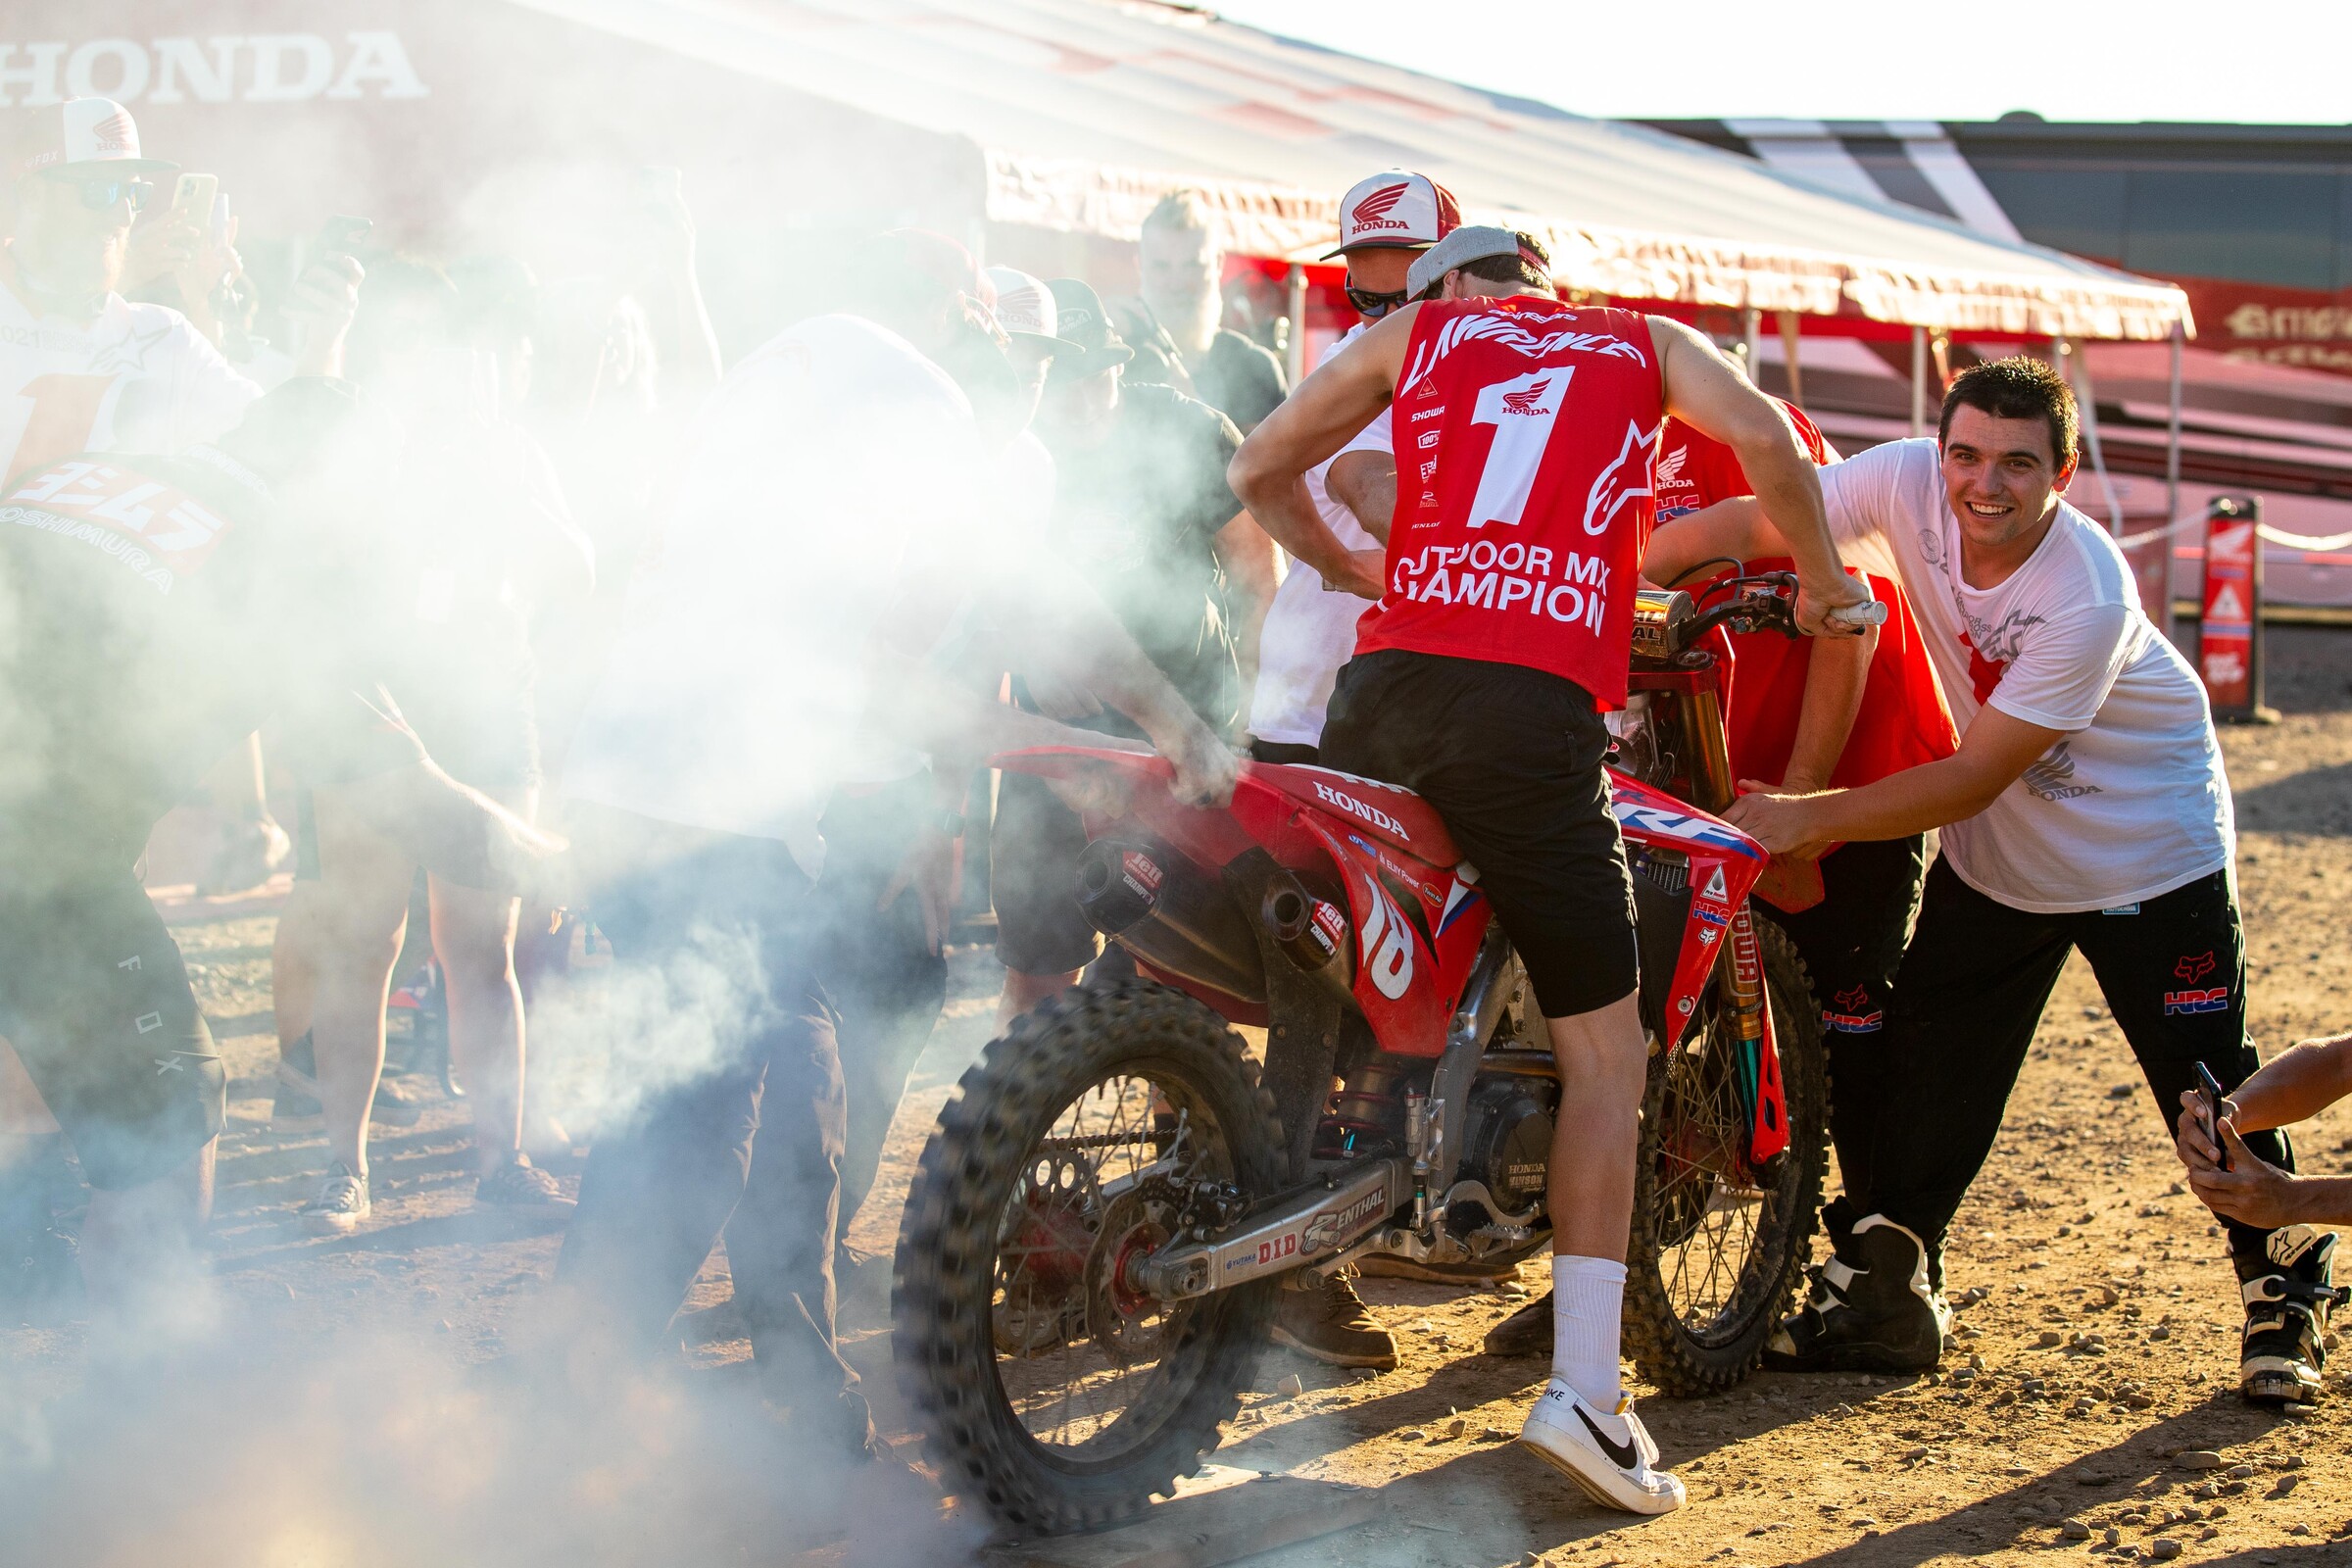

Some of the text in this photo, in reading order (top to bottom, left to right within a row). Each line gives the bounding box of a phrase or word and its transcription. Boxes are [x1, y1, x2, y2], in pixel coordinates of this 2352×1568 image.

[0, 30, 431, 107] HONDA
[1352, 220, 1409, 235] HONDA
[996, 312, 1042, 327] HOND
[0, 324, 39, 349] 021
[1411, 406, 1446, 423] SHOWA
[1501, 407, 1550, 416] HONDA
[1467, 366, 1575, 529] 1
[0, 506, 174, 596] OSHIMURA
[1564, 551, 1611, 597] MX
[1313, 781, 1410, 842] HONDA
[1361, 872, 1414, 1001] 18
[1733, 891, 1760, 984] HOWA
[2164, 987, 2229, 1016] HRC
[1822, 1009, 1883, 1034] HRC
[1509, 1162, 1546, 1174] HONDA
[1232, 1253, 1257, 1266] YUTAKA
[1258, 1233, 1297, 1265] D.I.D
